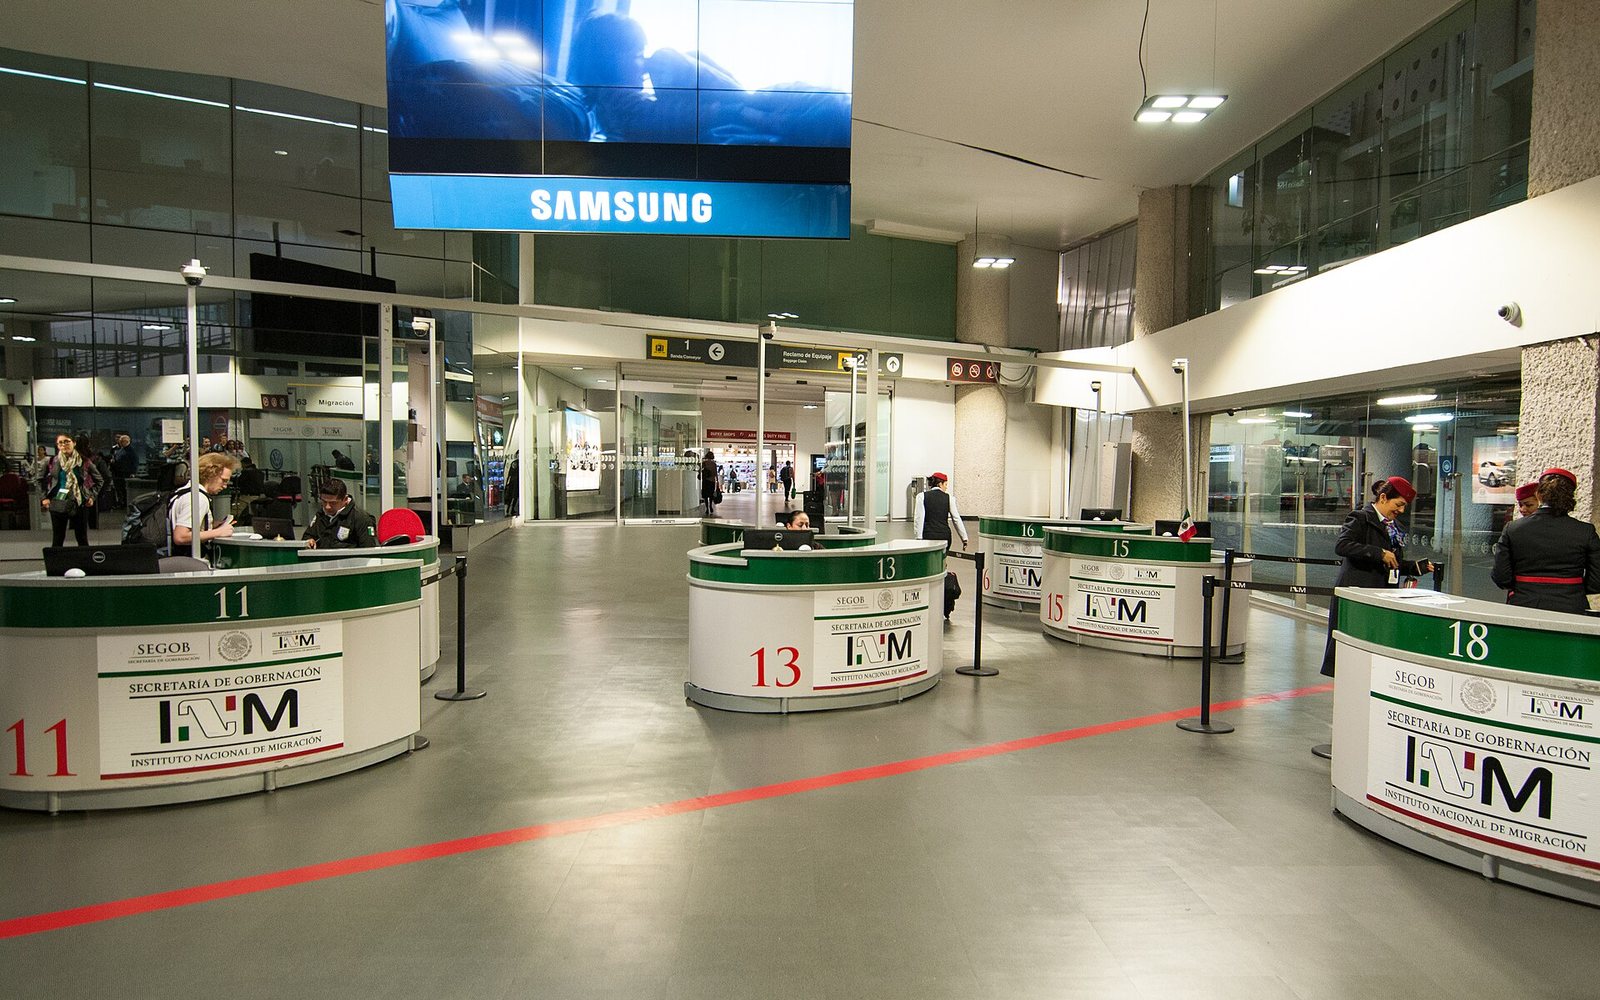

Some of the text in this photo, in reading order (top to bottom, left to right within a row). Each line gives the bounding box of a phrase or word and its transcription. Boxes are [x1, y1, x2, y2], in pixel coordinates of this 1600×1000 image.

[530, 188, 713, 223] SAMSUNG
[684, 339, 690, 350] 1
[783, 350, 804, 358] Reclamo
[811, 352, 832, 361] Equipaje
[857, 354, 867, 366] 2
[296, 398, 354, 407] 63 Migración
[731, 530, 744, 543] 14
[1021, 523, 1035, 537] 16
[1112, 539, 1129, 558] 15
[877, 557, 896, 580] 13
[1081, 564, 1099, 572] SEGOB
[1115, 587, 1161, 597] GOBERNACIÓN
[214, 585, 249, 619] 11
[836, 596, 865, 605] SEGOB
[1047, 592, 1063, 622] 15
[875, 620, 883, 628] DE
[884, 615, 921, 627] GOBERNACIÓN
[1097, 623, 1121, 632] NACIONAL
[138, 642, 190, 655] SEGOB
[1448, 620, 1489, 661] 18
[750, 646, 801, 687] 13
[129, 667, 321, 693] SECRETARÍA DE GOBERNACIÓN
[830, 674, 863, 682] INSTITUTO
[864, 670, 890, 679] NACIONAL
[1395, 670, 1435, 689] SEGOB
[1387, 709, 1591, 763] SECRETARÍA DE GOBERNACIÓN
[6, 718, 77, 776] 11
[131, 735, 322, 767] INSTITUTO NACIONAL DE MIGRACIÓN
[1385, 788, 1586, 853] INSTITUTO NACIONAL DE MIGRACIÓN
